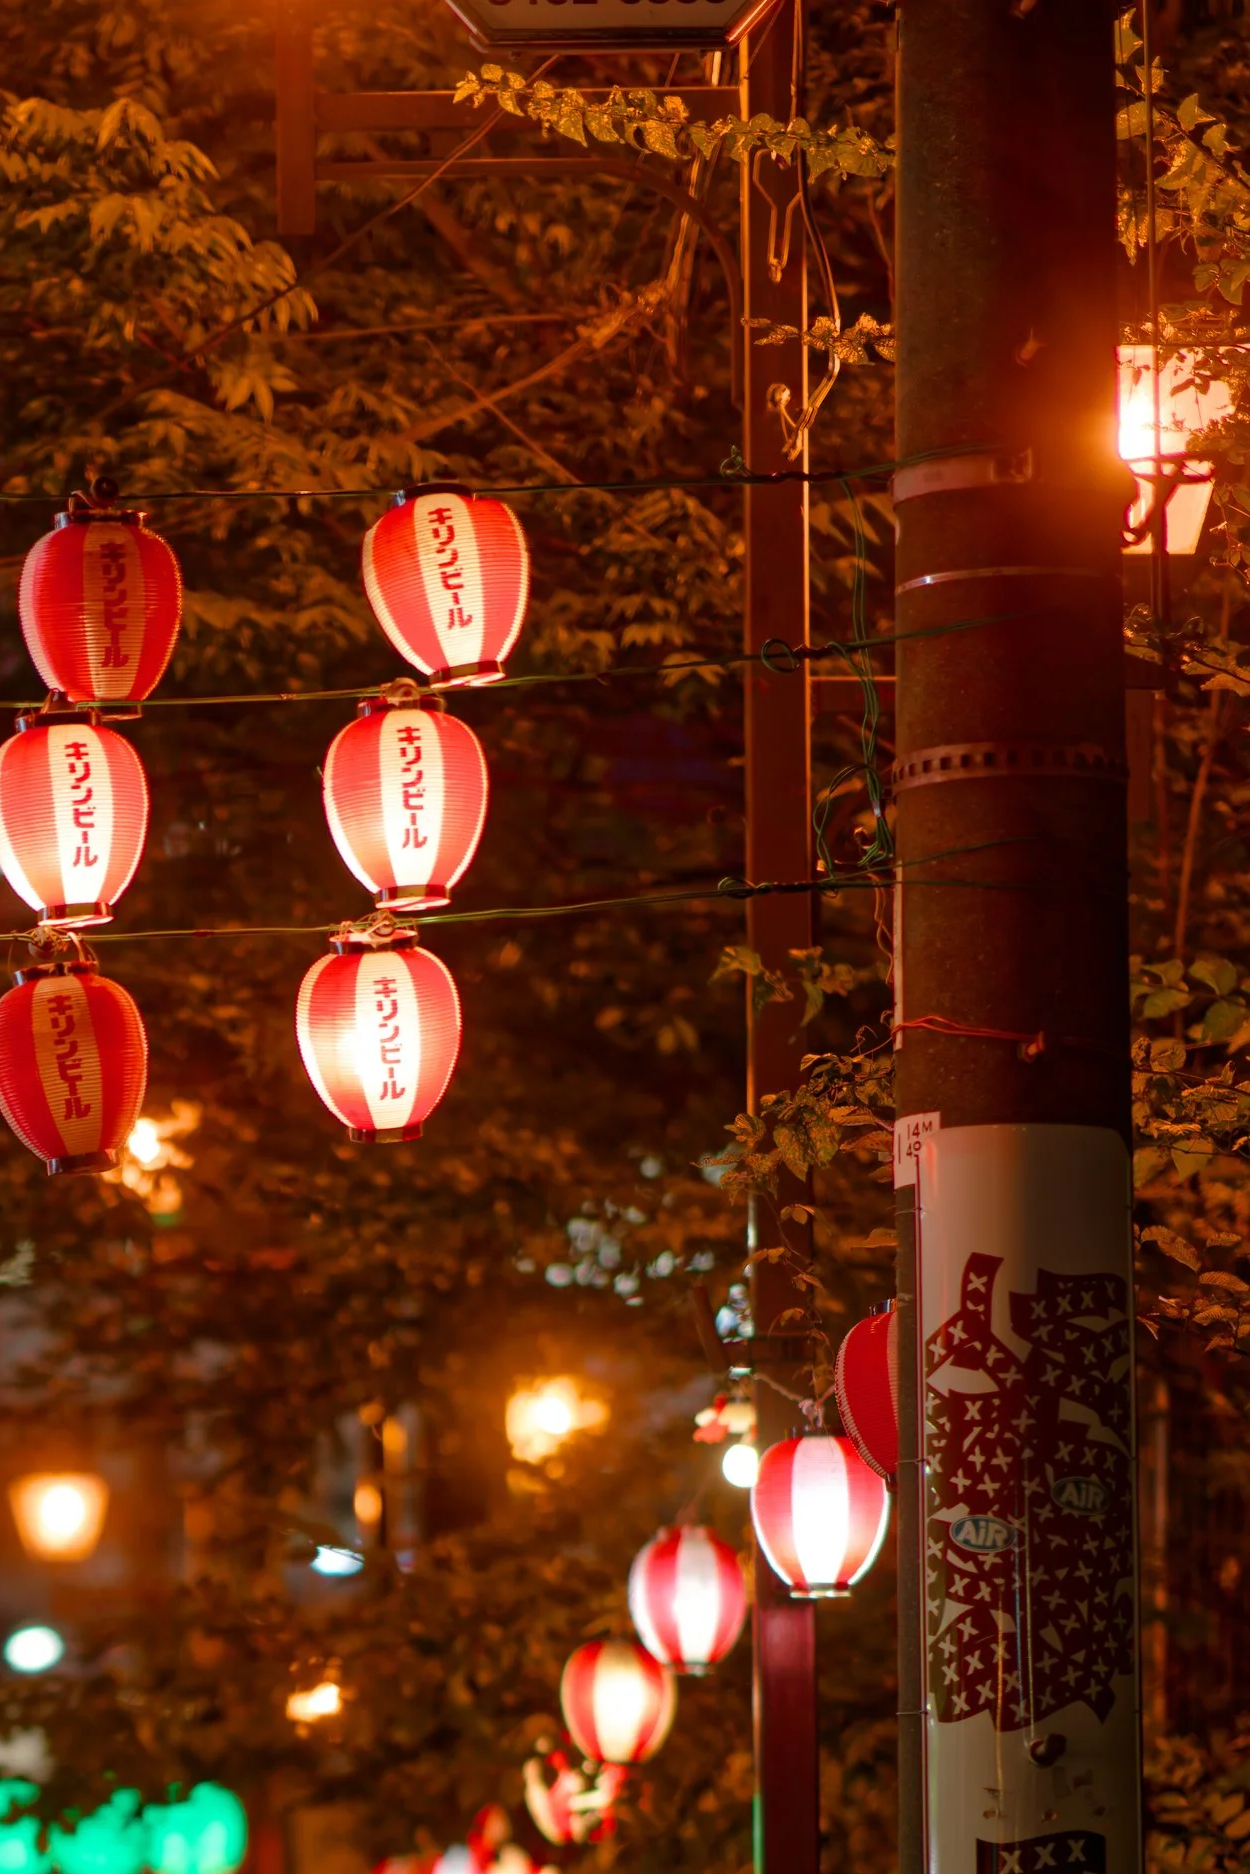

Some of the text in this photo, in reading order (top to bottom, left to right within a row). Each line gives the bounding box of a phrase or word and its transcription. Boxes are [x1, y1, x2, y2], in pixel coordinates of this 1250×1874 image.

[100, 540, 130, 669] キリンビール
[428, 506, 474, 632] キリンビール
[63, 739, 99, 869] キリンビール
[396, 725, 429, 851] キリンビール
[46, 991, 93, 1123] キリンビール
[373, 975, 407, 1102] キリンビール
